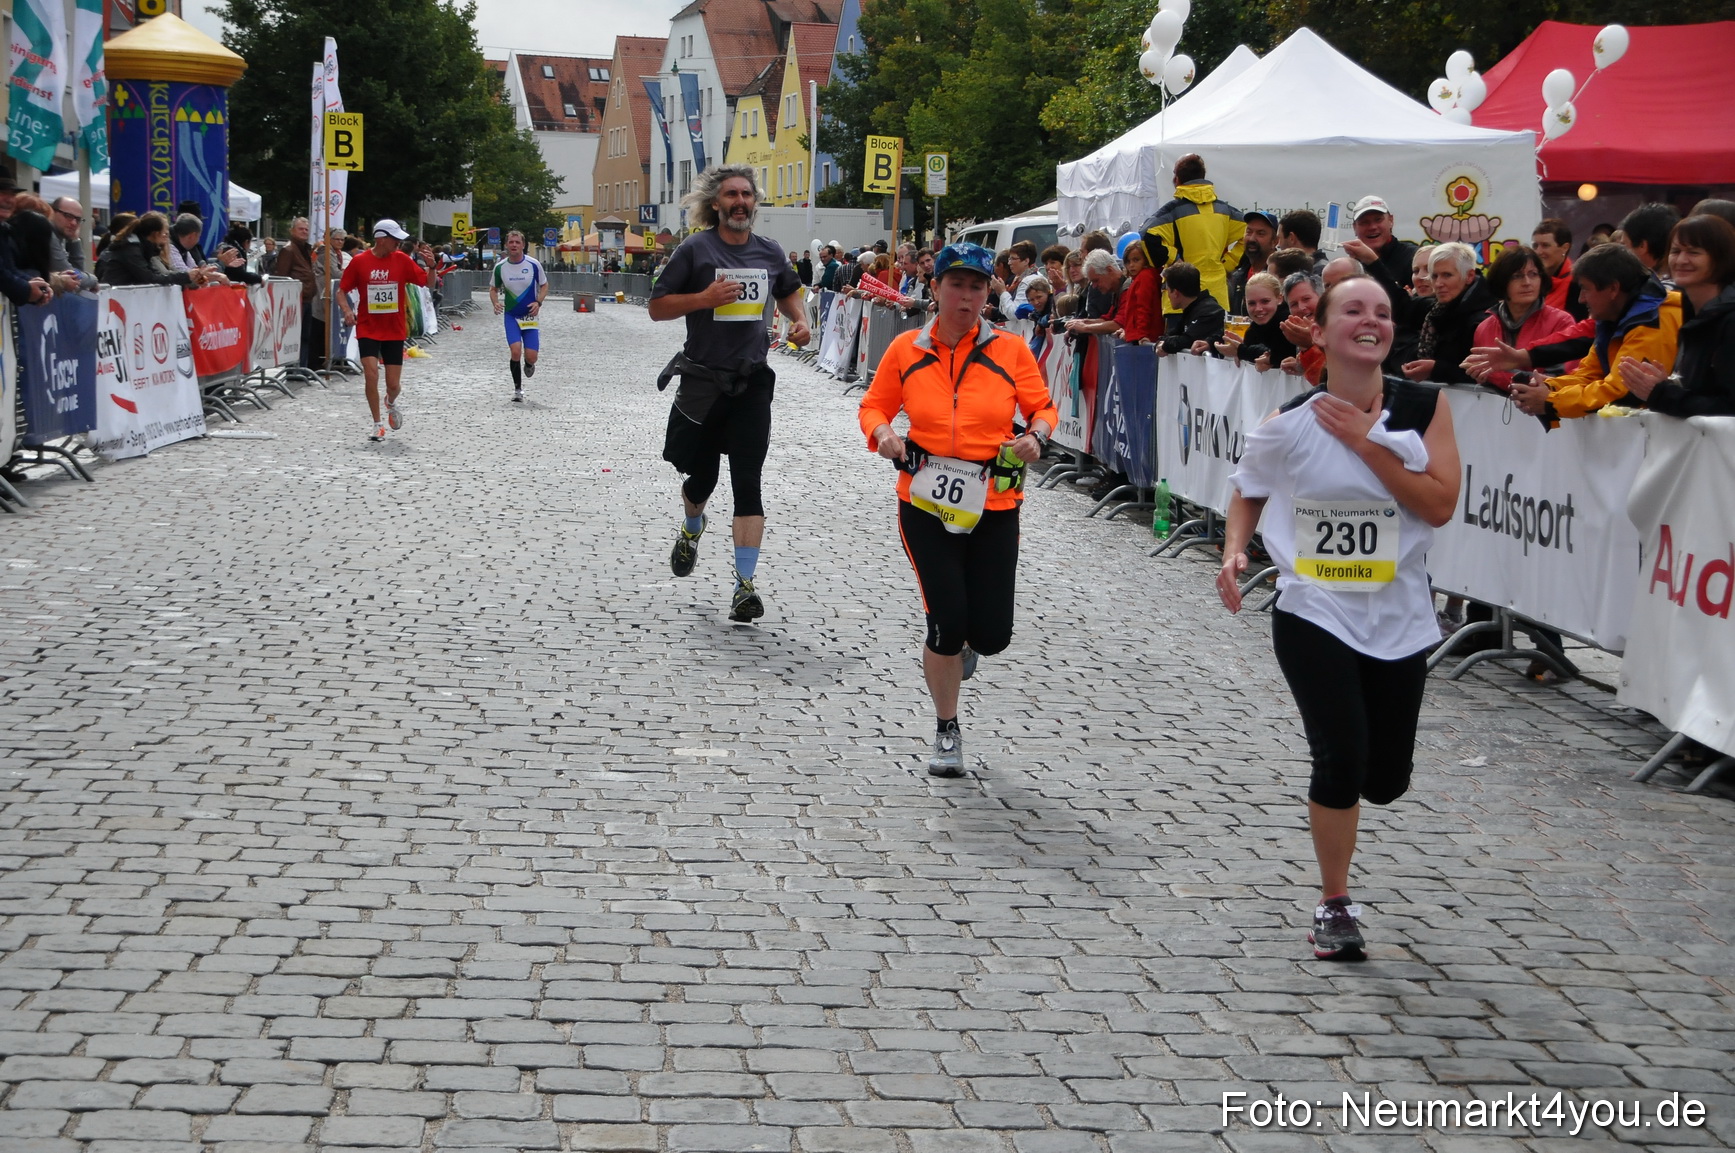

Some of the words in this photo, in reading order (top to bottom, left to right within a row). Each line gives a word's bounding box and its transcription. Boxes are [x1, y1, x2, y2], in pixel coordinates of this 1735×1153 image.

[329, 114, 359, 126] Block
[335, 130, 354, 158] B
[871, 138, 899, 150] Block
[874, 153, 892, 181] B
[456, 219, 465, 232] C
[646, 236, 654, 247] D
[374, 291, 394, 303] 434
[943, 464, 978, 479] Neumarkt
[931, 474, 965, 504] 36
[1295, 507, 1328, 518] PARTL
[1330, 508, 1380, 518] Neumarkt
[1463, 463, 1575, 557] Laufsport
[1315, 520, 1378, 556] 230
[1315, 563, 1373, 579] Veronika
